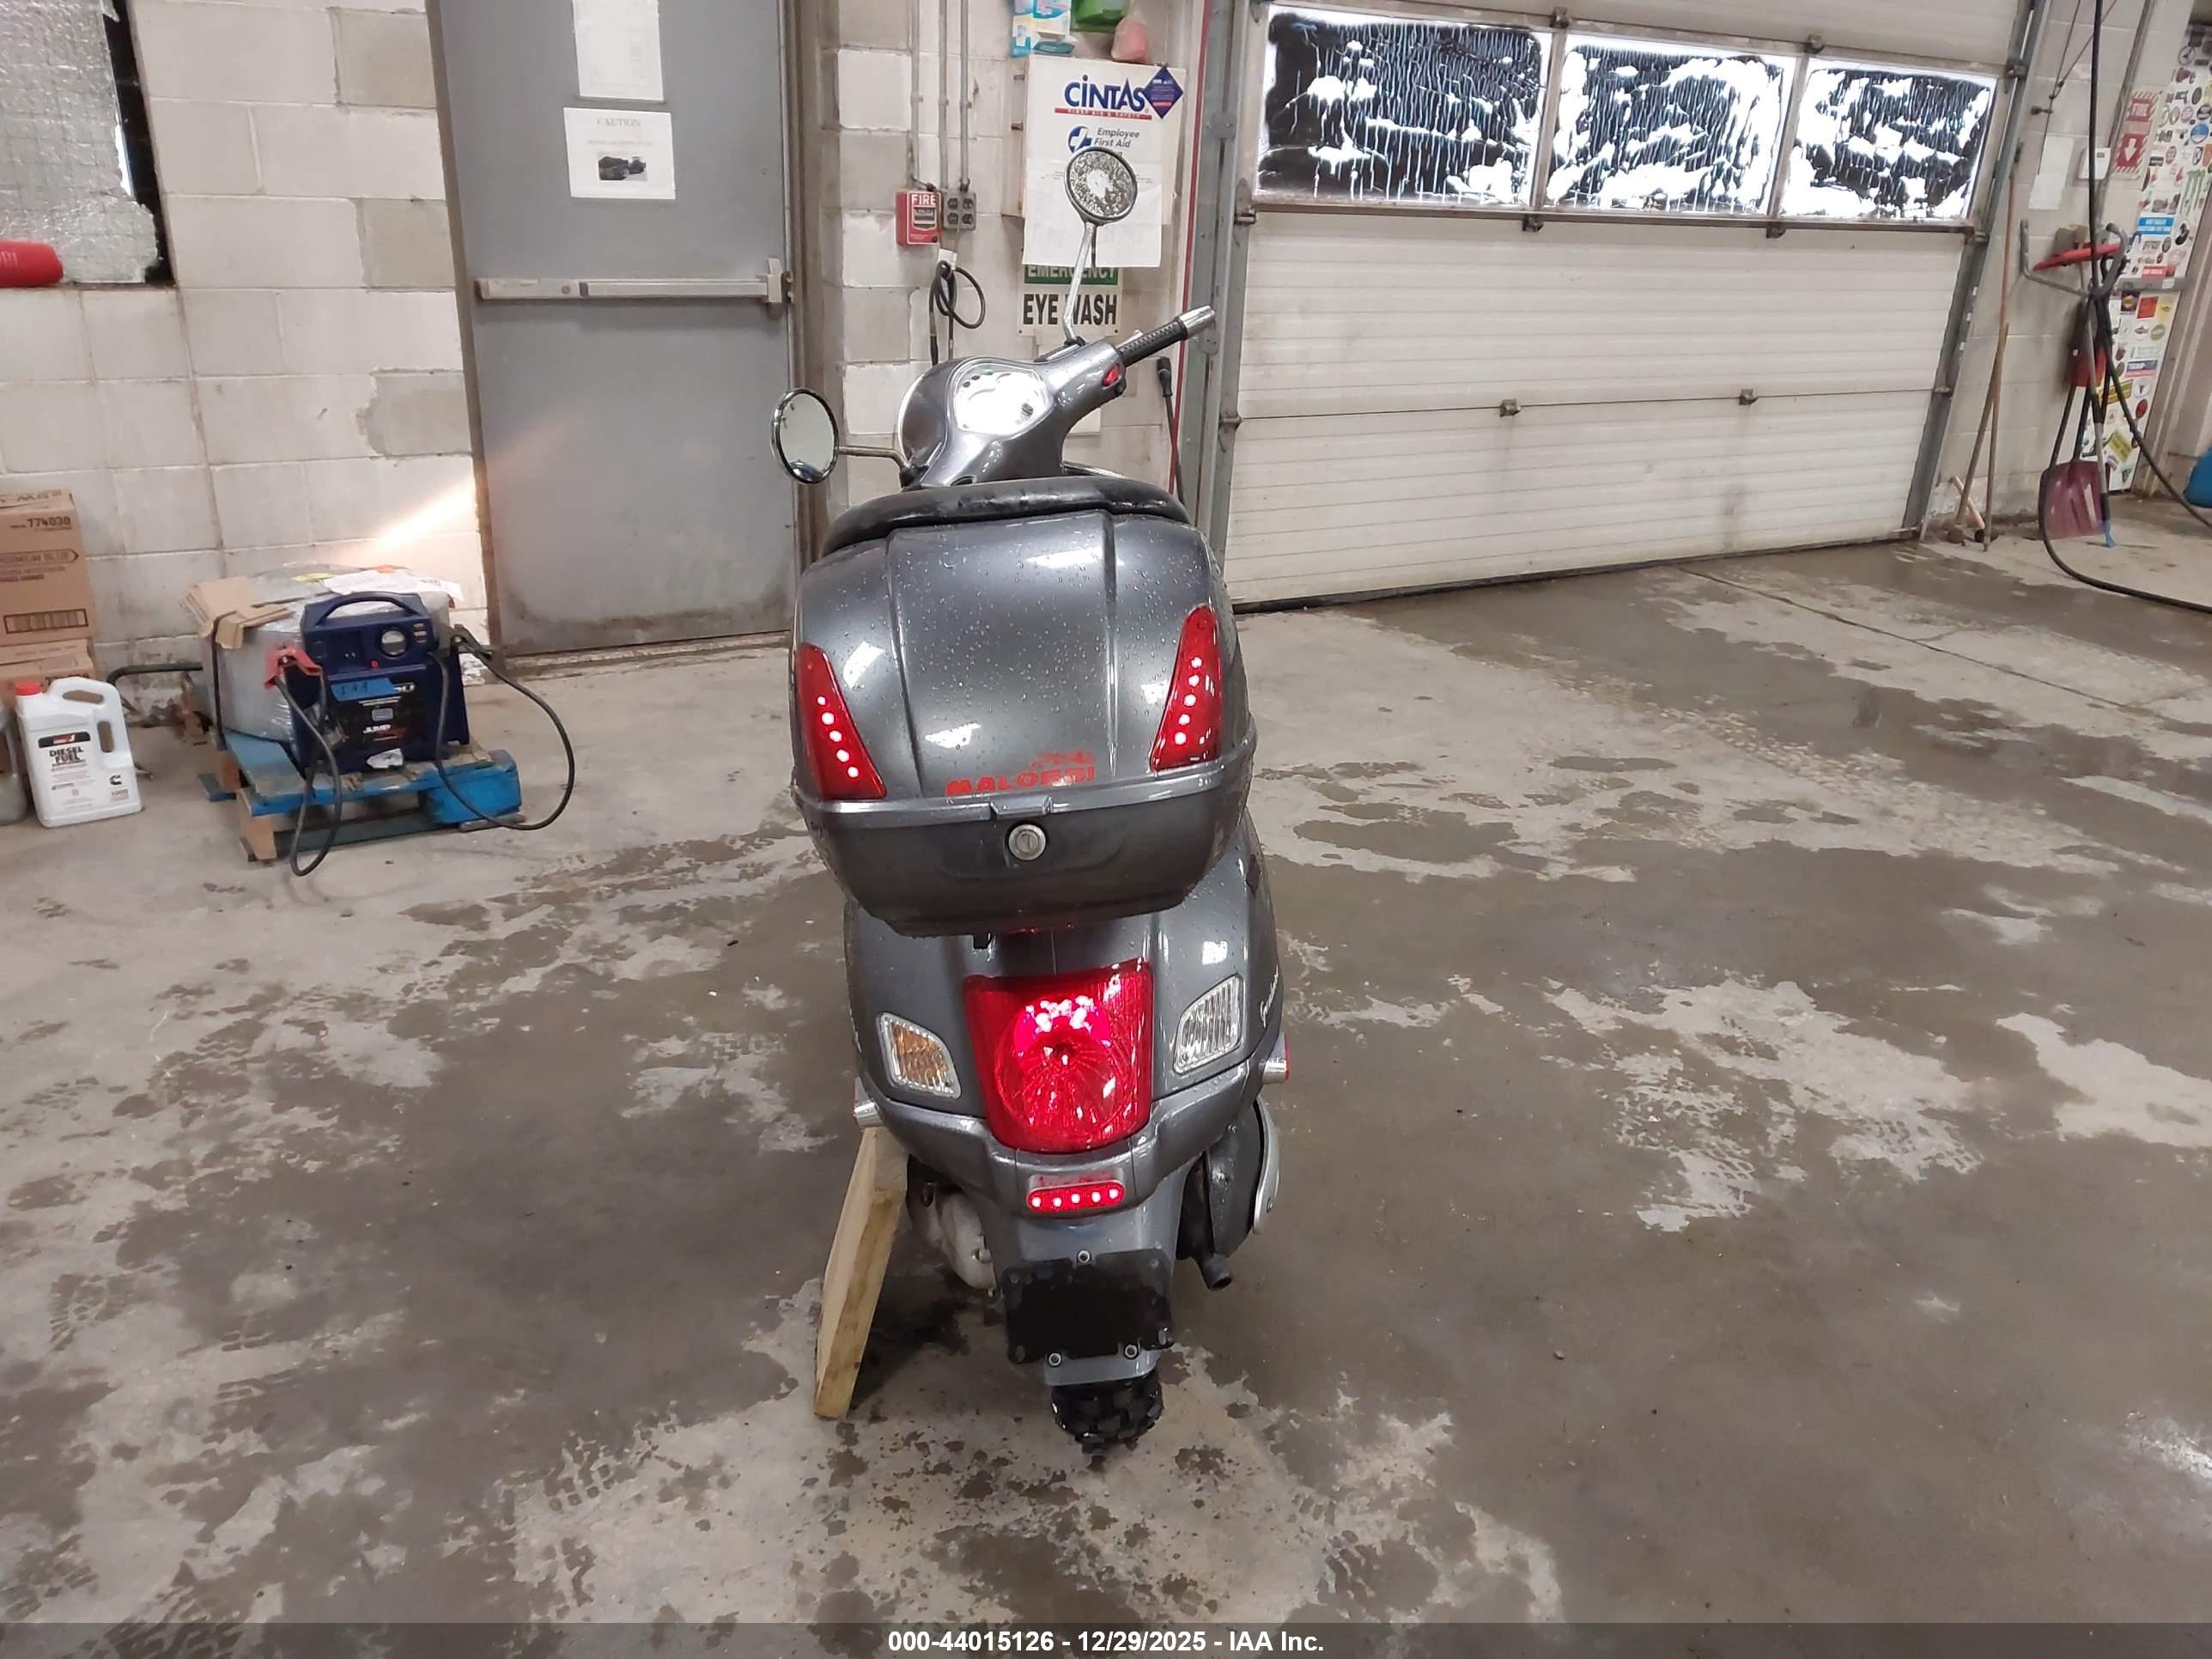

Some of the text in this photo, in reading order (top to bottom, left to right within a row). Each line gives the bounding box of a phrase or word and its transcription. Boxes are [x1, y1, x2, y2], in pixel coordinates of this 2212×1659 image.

[1064, 74, 1146, 112] CINTAS
[596, 118, 641, 126] CAUTION
[1097, 128, 1140, 139] Employee
[1094, 138, 1131, 149] First Aid
[911, 193, 937, 206] FIRE
[1028, 264, 1115, 279] EMERNCY
[1023, 294, 1059, 325] EYE
[49, 745, 84, 757] DIESEL
[54, 752, 82, 763] FUEL
